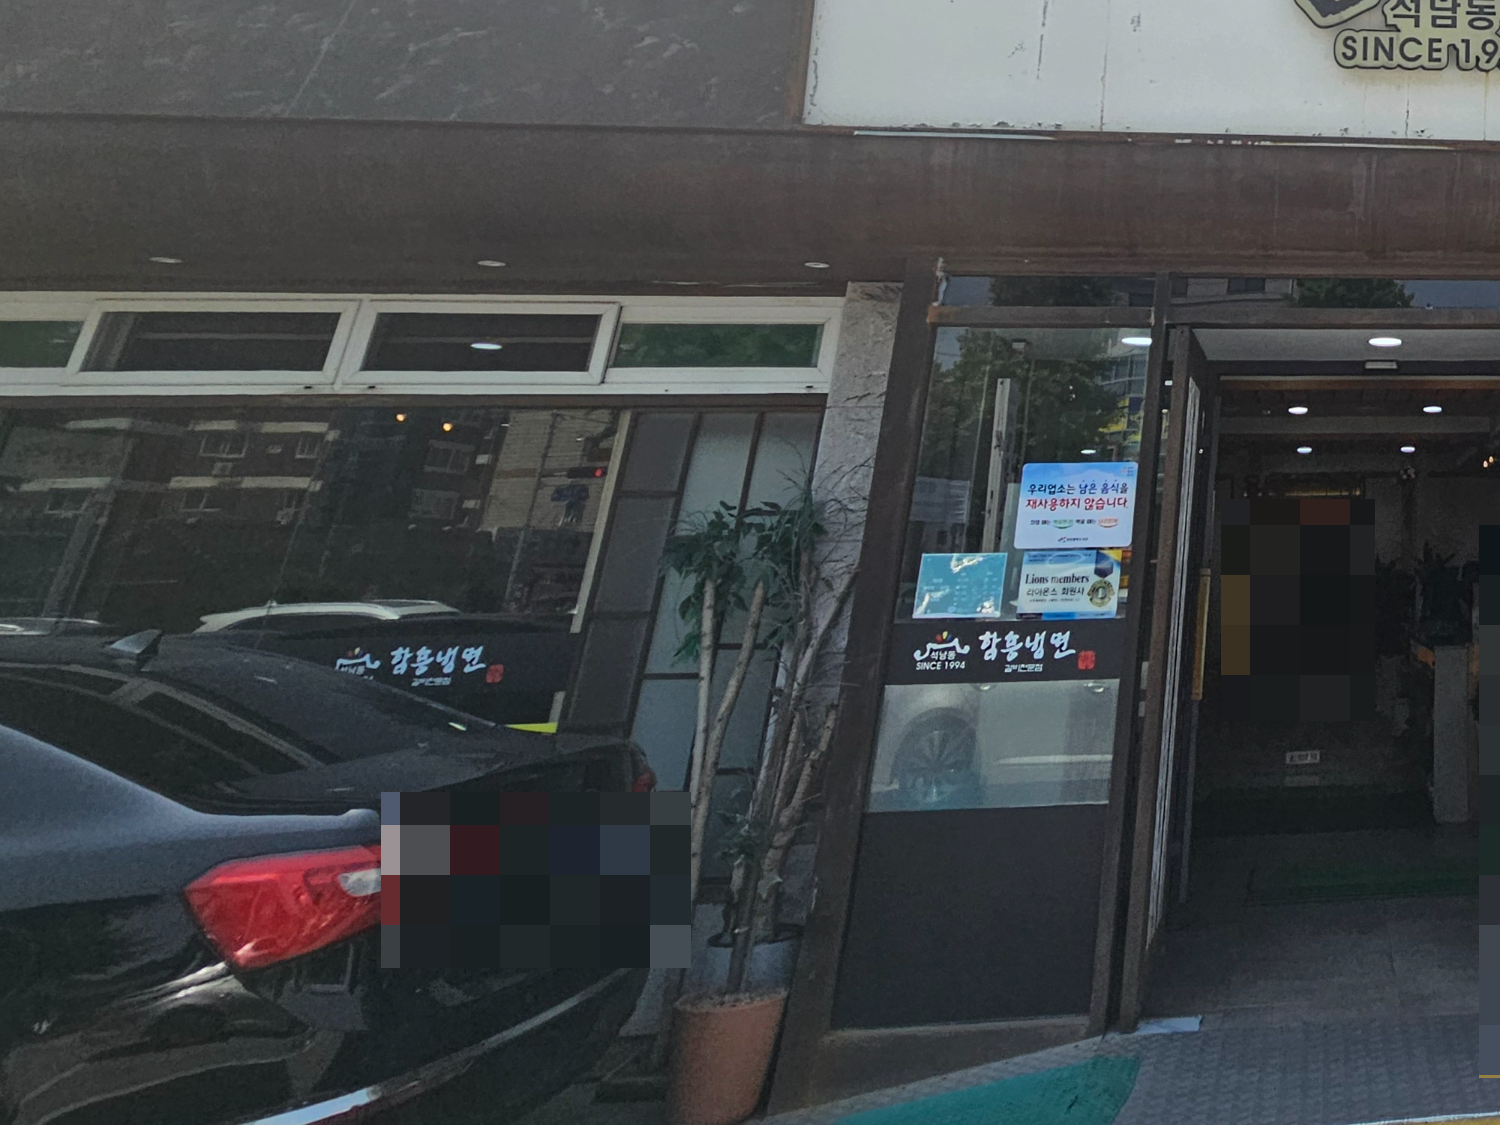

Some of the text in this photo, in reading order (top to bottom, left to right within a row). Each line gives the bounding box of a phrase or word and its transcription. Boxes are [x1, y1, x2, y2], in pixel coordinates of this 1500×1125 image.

[1341, 35, 1443, 63] SINCE
[1027, 481, 1129, 495] 우리업소는 남은 음식을
[1025, 497, 1081, 512] 재사용하지
[1025, 573, 1089, 585] Lions members
[1026, 586, 1085, 597] 라이온스 회원사
[978, 630, 1076, 662] 함흥냉면
[390, 645, 487, 676] 함흥냉면
[916, 660, 966, 671] SINCE 1994
